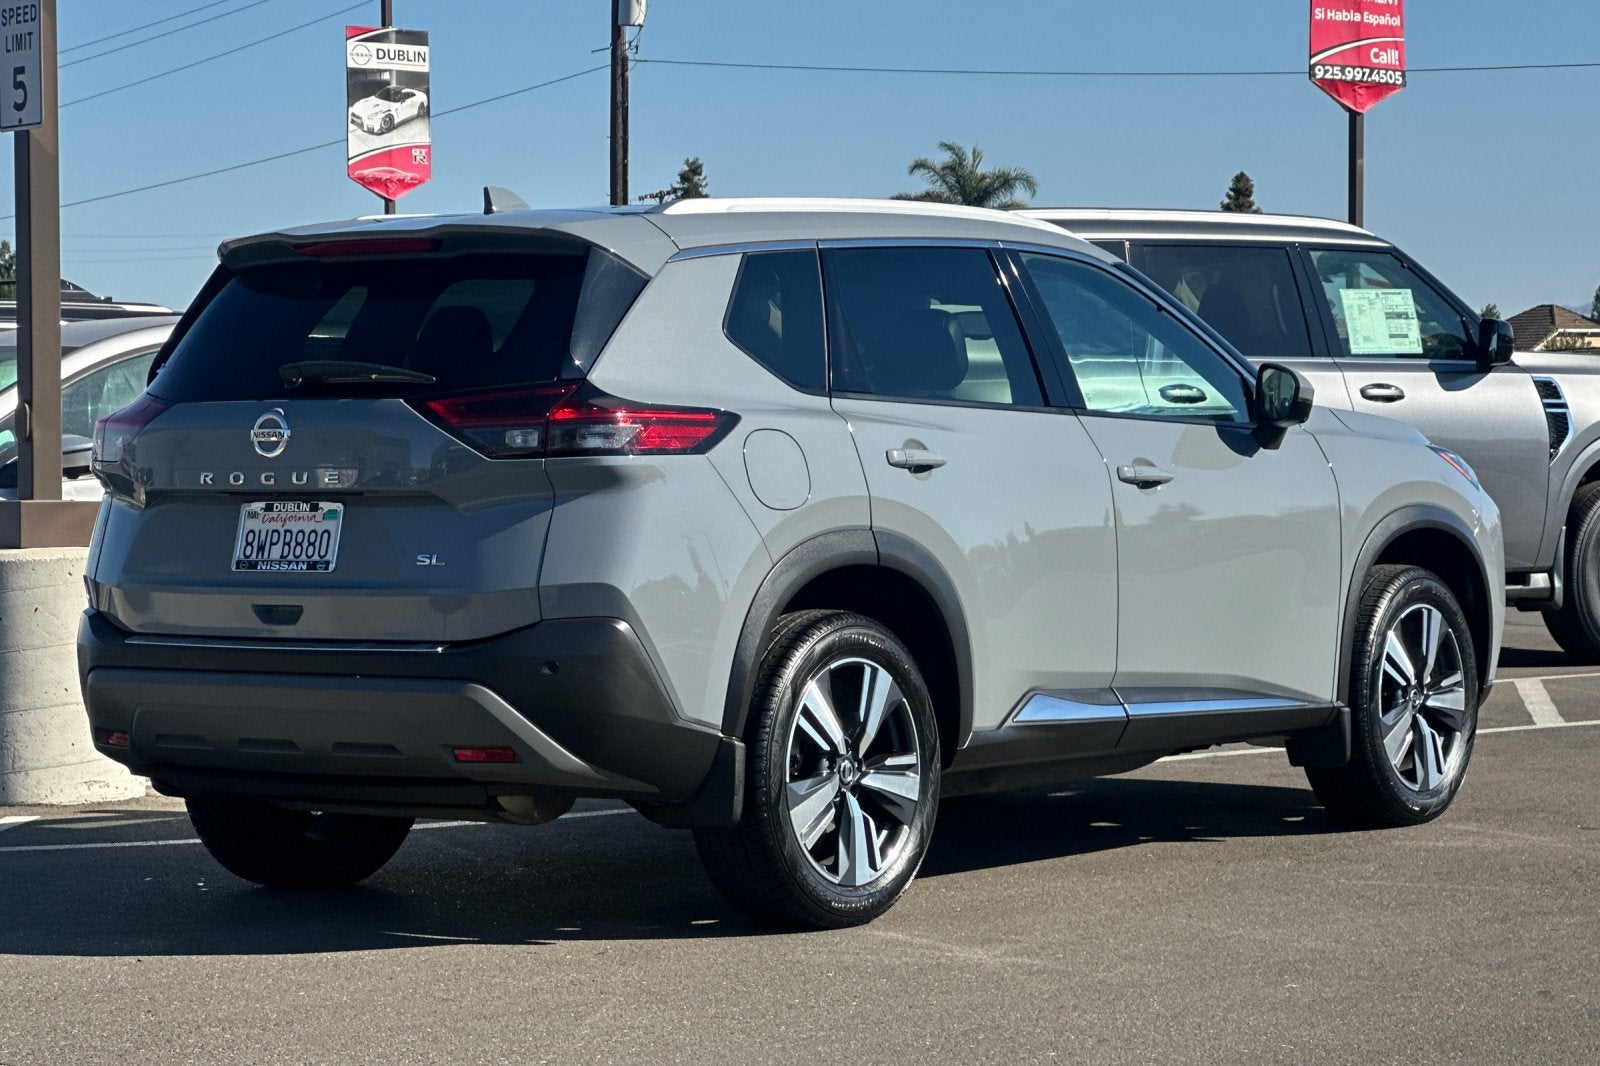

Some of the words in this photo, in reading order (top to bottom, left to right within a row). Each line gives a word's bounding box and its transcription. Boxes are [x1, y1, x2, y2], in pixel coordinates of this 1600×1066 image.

[1, 4, 37, 27] SPEED
[1315, 8, 1325, 20] Si
[1327, 9, 1361, 22] Habla
[1363, 11, 1400, 26] Español
[5, 31, 34, 53] LIMIT
[376, 48, 426, 63] DUBLIN
[1370, 47, 1399, 65] Call!
[1315, 65, 1403, 85] 925.997.4505
[13, 65, 28, 112] 5
[253, 431, 285, 440] NISSAN
[199, 471, 339, 486] ROGUE
[273, 503, 311, 512] DUBLIN
[261, 512, 323, 528] California
[243, 529, 332, 560] 8WPB880
[257, 561, 307, 570] NISSAN
[416, 554, 446, 566] SL
